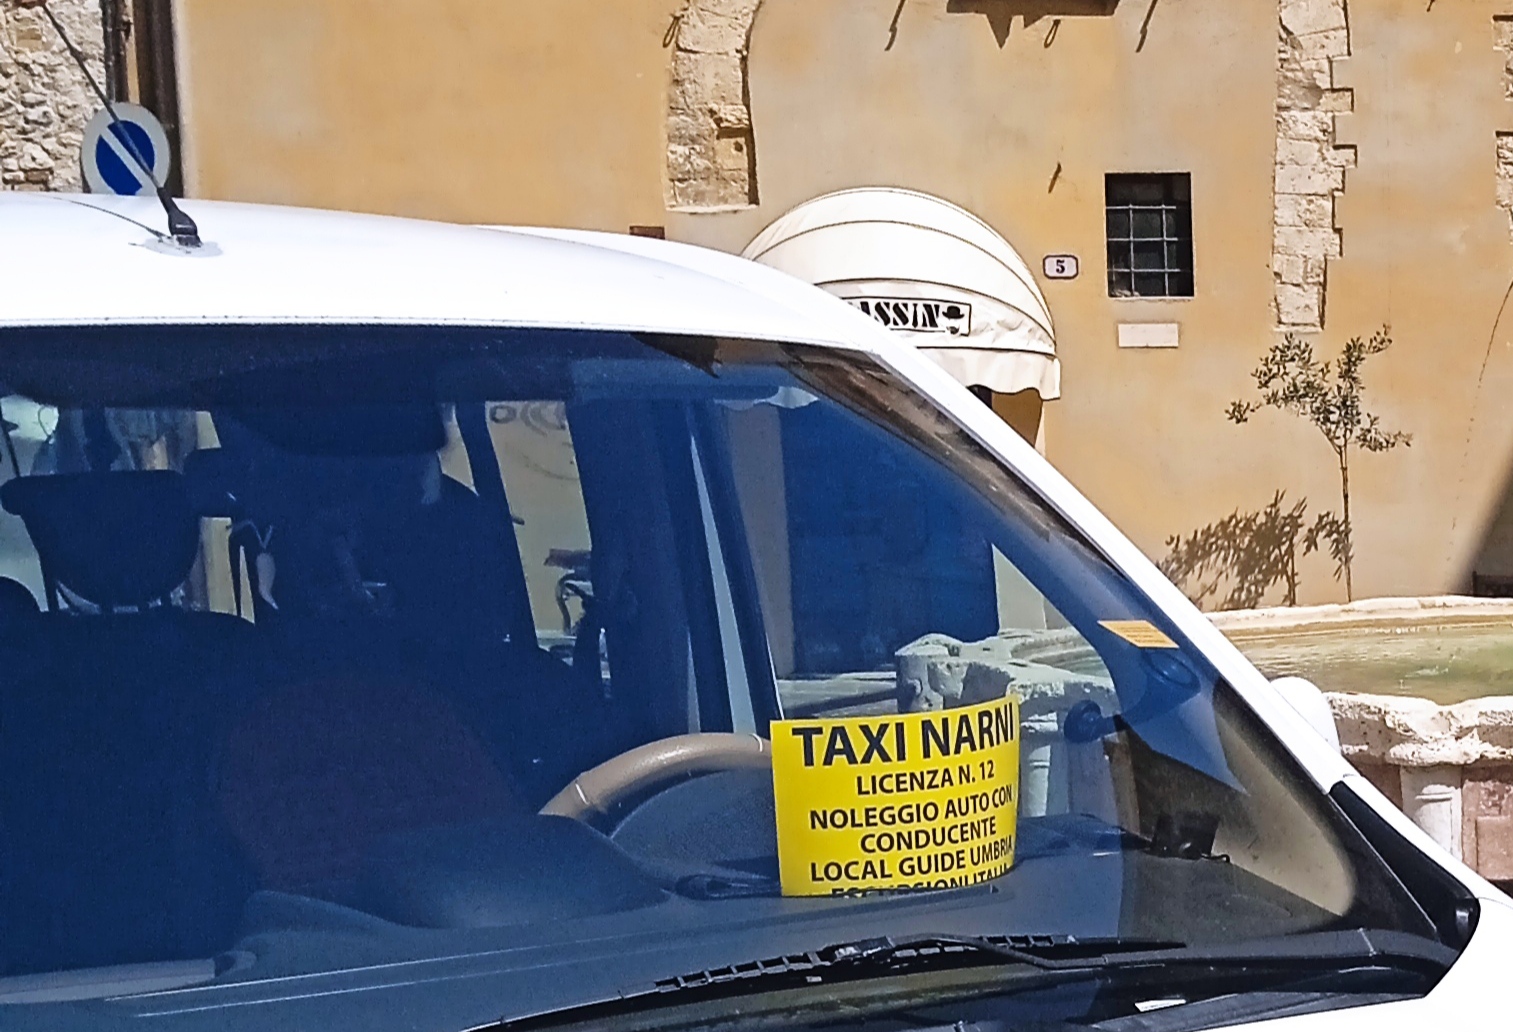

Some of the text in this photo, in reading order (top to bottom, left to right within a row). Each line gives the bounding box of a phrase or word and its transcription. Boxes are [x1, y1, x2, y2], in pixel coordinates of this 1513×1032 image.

[1056, 259, 1065, 274] 5
[792, 702, 1014, 768] TAXI NARNI
[857, 760, 995, 795] LICENZA N. 12
[810, 784, 1012, 830] NOLEGGIO AUTO CON
[860, 816, 997, 853] CONDUCENTE
[811, 835, 1013, 882] LOCAL GUIDE UMBRIA
